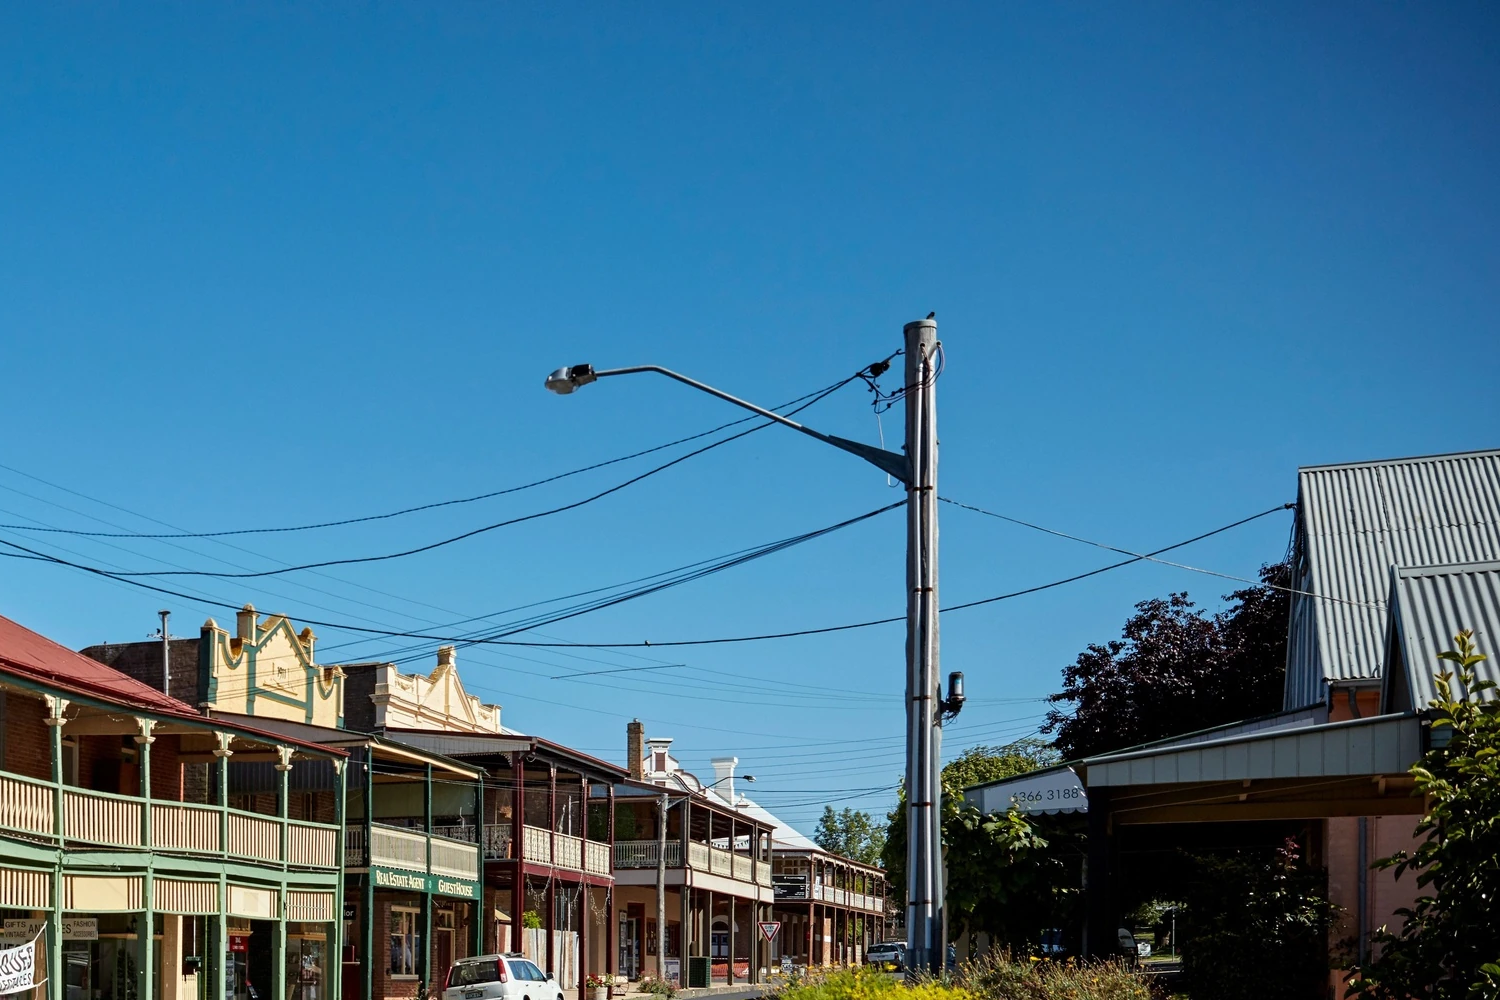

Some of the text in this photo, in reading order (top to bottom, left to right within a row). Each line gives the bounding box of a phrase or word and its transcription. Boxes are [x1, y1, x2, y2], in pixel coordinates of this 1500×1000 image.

[1012, 788, 1079, 802] 6366 3188
[28, 923, 72, 934] ANES
